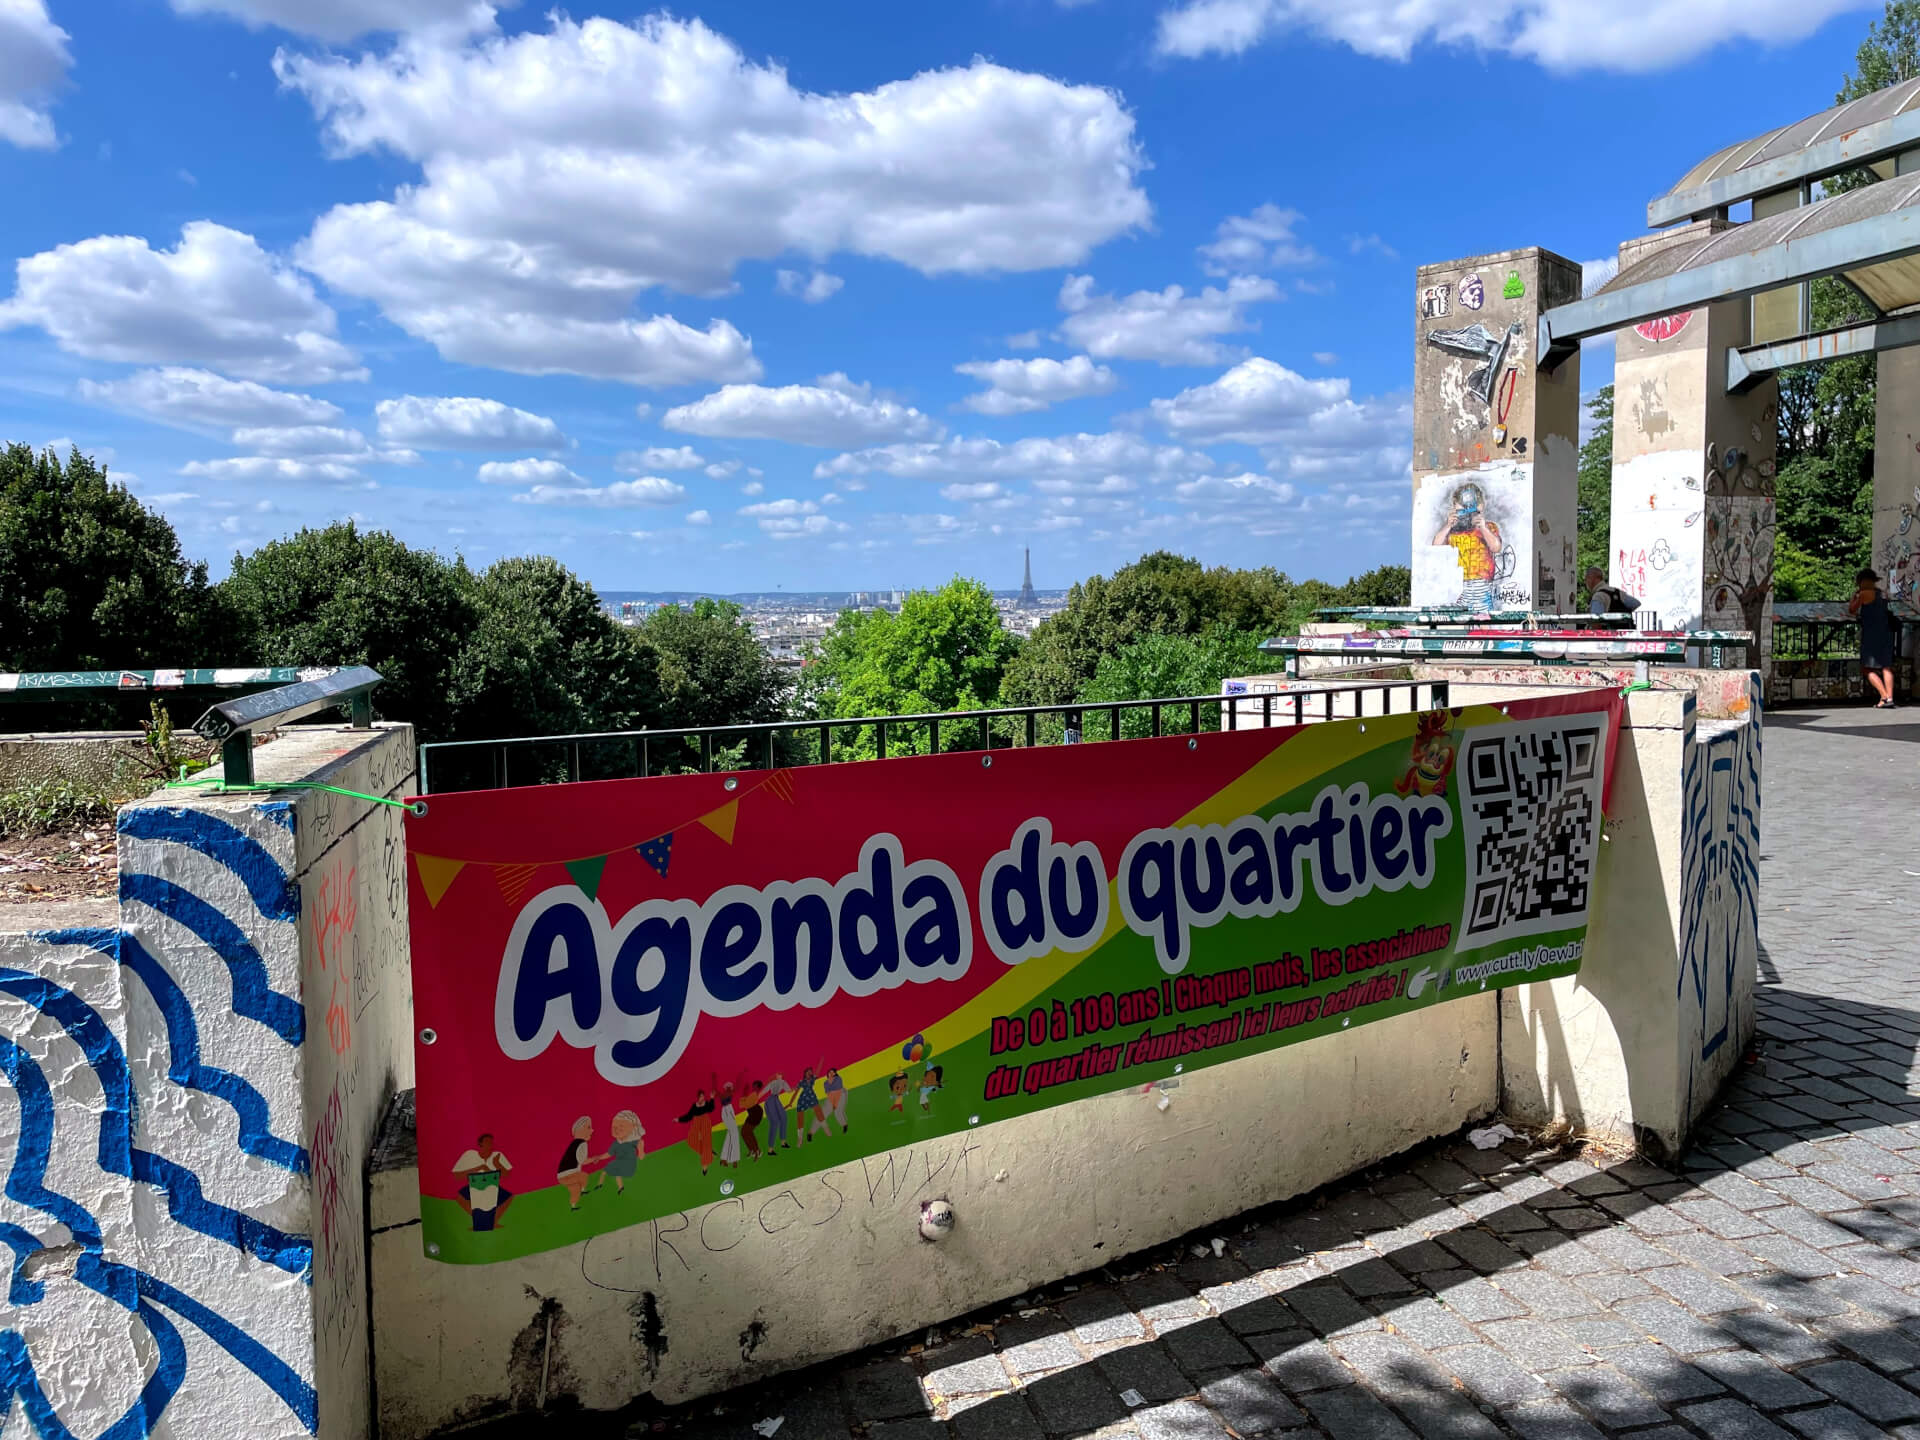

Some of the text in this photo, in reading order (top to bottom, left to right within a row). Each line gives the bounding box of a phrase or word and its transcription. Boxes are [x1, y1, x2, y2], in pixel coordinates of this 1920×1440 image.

[512, 846, 962, 1071] Agenda
[990, 828, 1099, 952] du
[1126, 791, 1446, 962] quartier
[990, 1015, 1024, 1055] De
[1051, 999, 1068, 1042] à
[1071, 992, 1115, 1037] 108
[1118, 986, 1160, 1026] ans
[1161, 979, 1172, 1016] !
[1174, 967, 1251, 1013] Chaque
[1254, 952, 1310, 995] mois,
[1311, 947, 1342, 982] les
[1345, 922, 1452, 974] associations
[984, 968, 1408, 1101] du quartier réunissent ici leurs activités !
